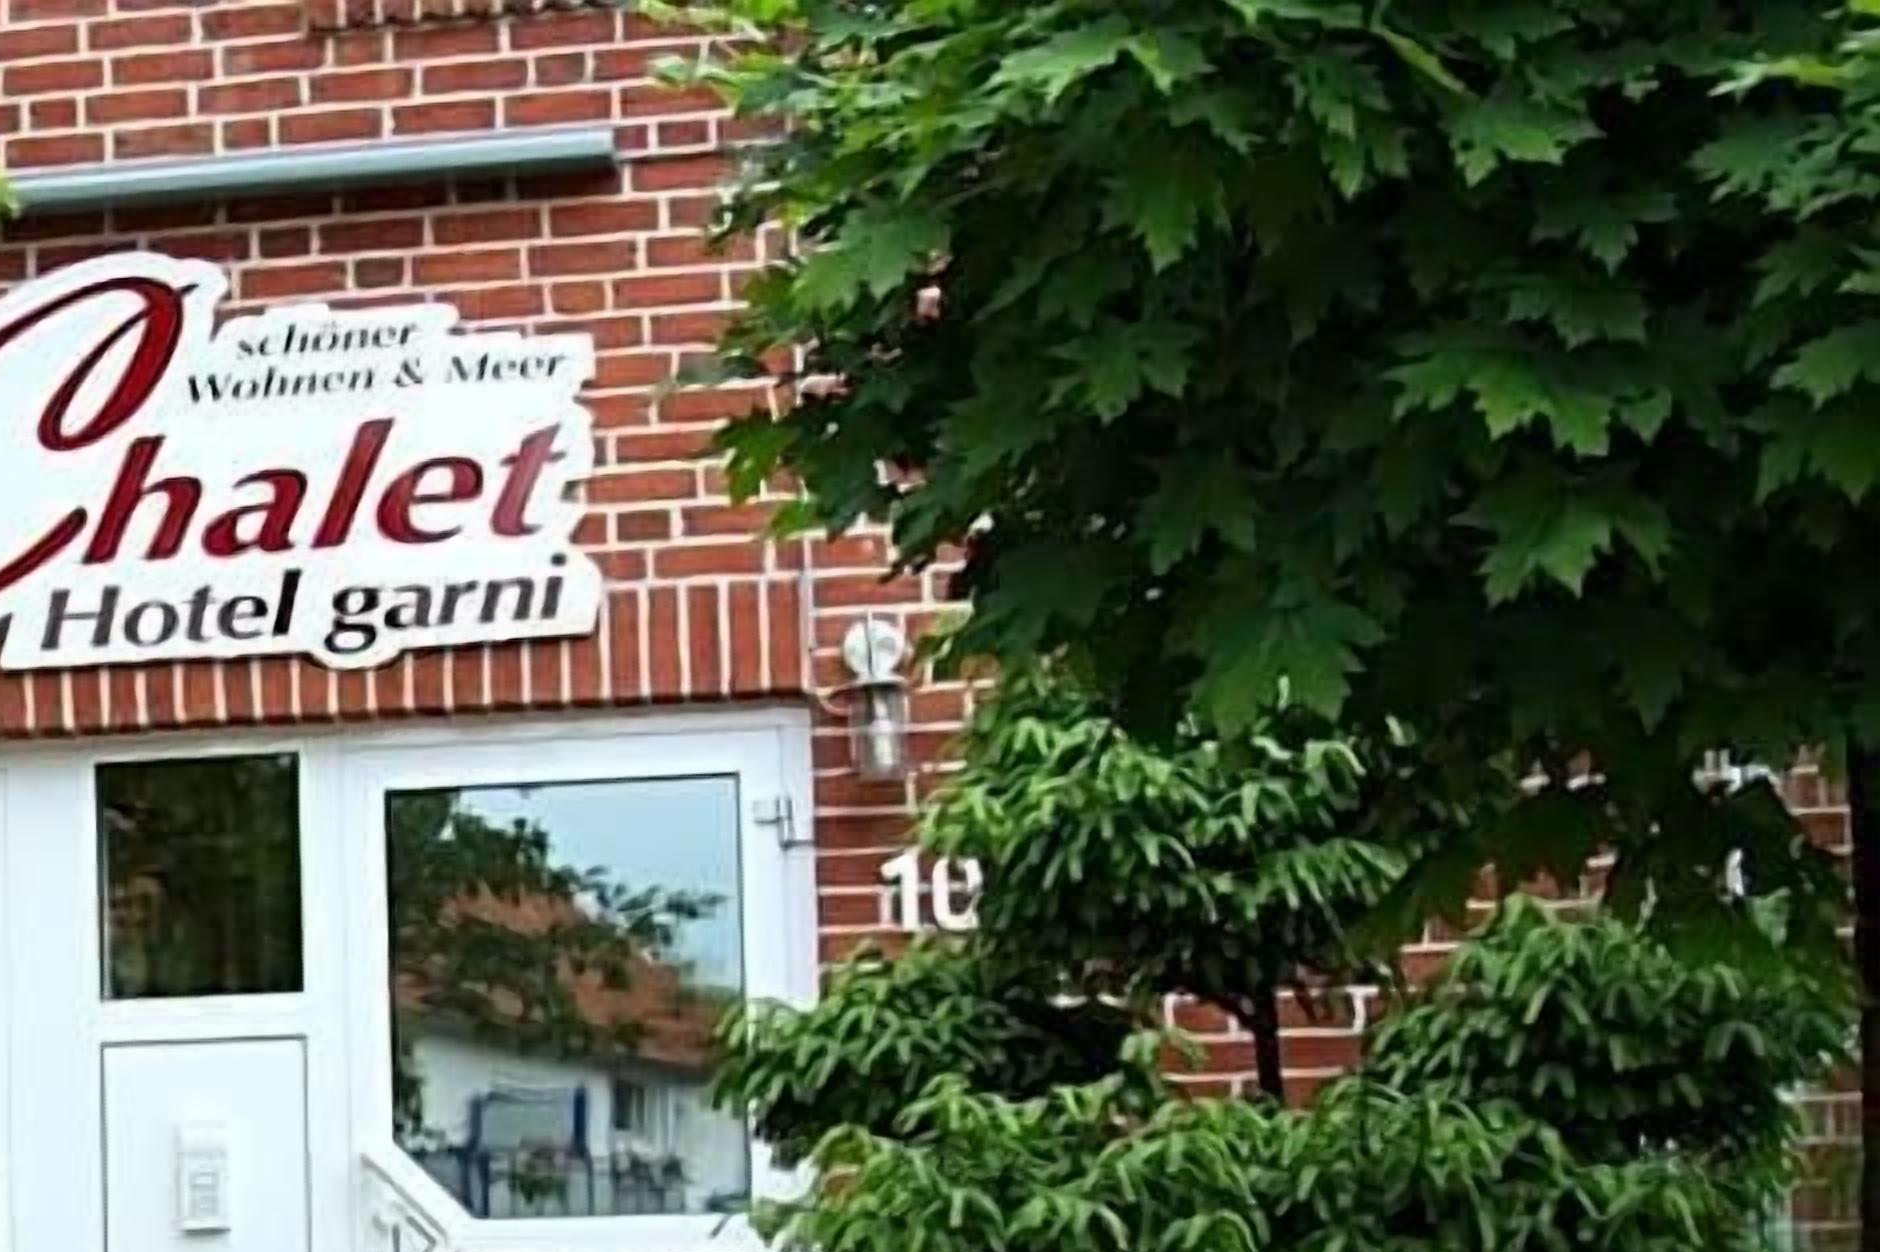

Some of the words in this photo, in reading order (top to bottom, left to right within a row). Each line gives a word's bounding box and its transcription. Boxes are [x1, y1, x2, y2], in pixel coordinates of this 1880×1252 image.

[236, 320, 419, 359] schöner
[186, 365, 376, 404] Wohnen
[395, 356, 426, 389] &
[446, 351, 567, 385] Meer
[40, 568, 302, 652] Hotel
[323, 553, 569, 655] garni
